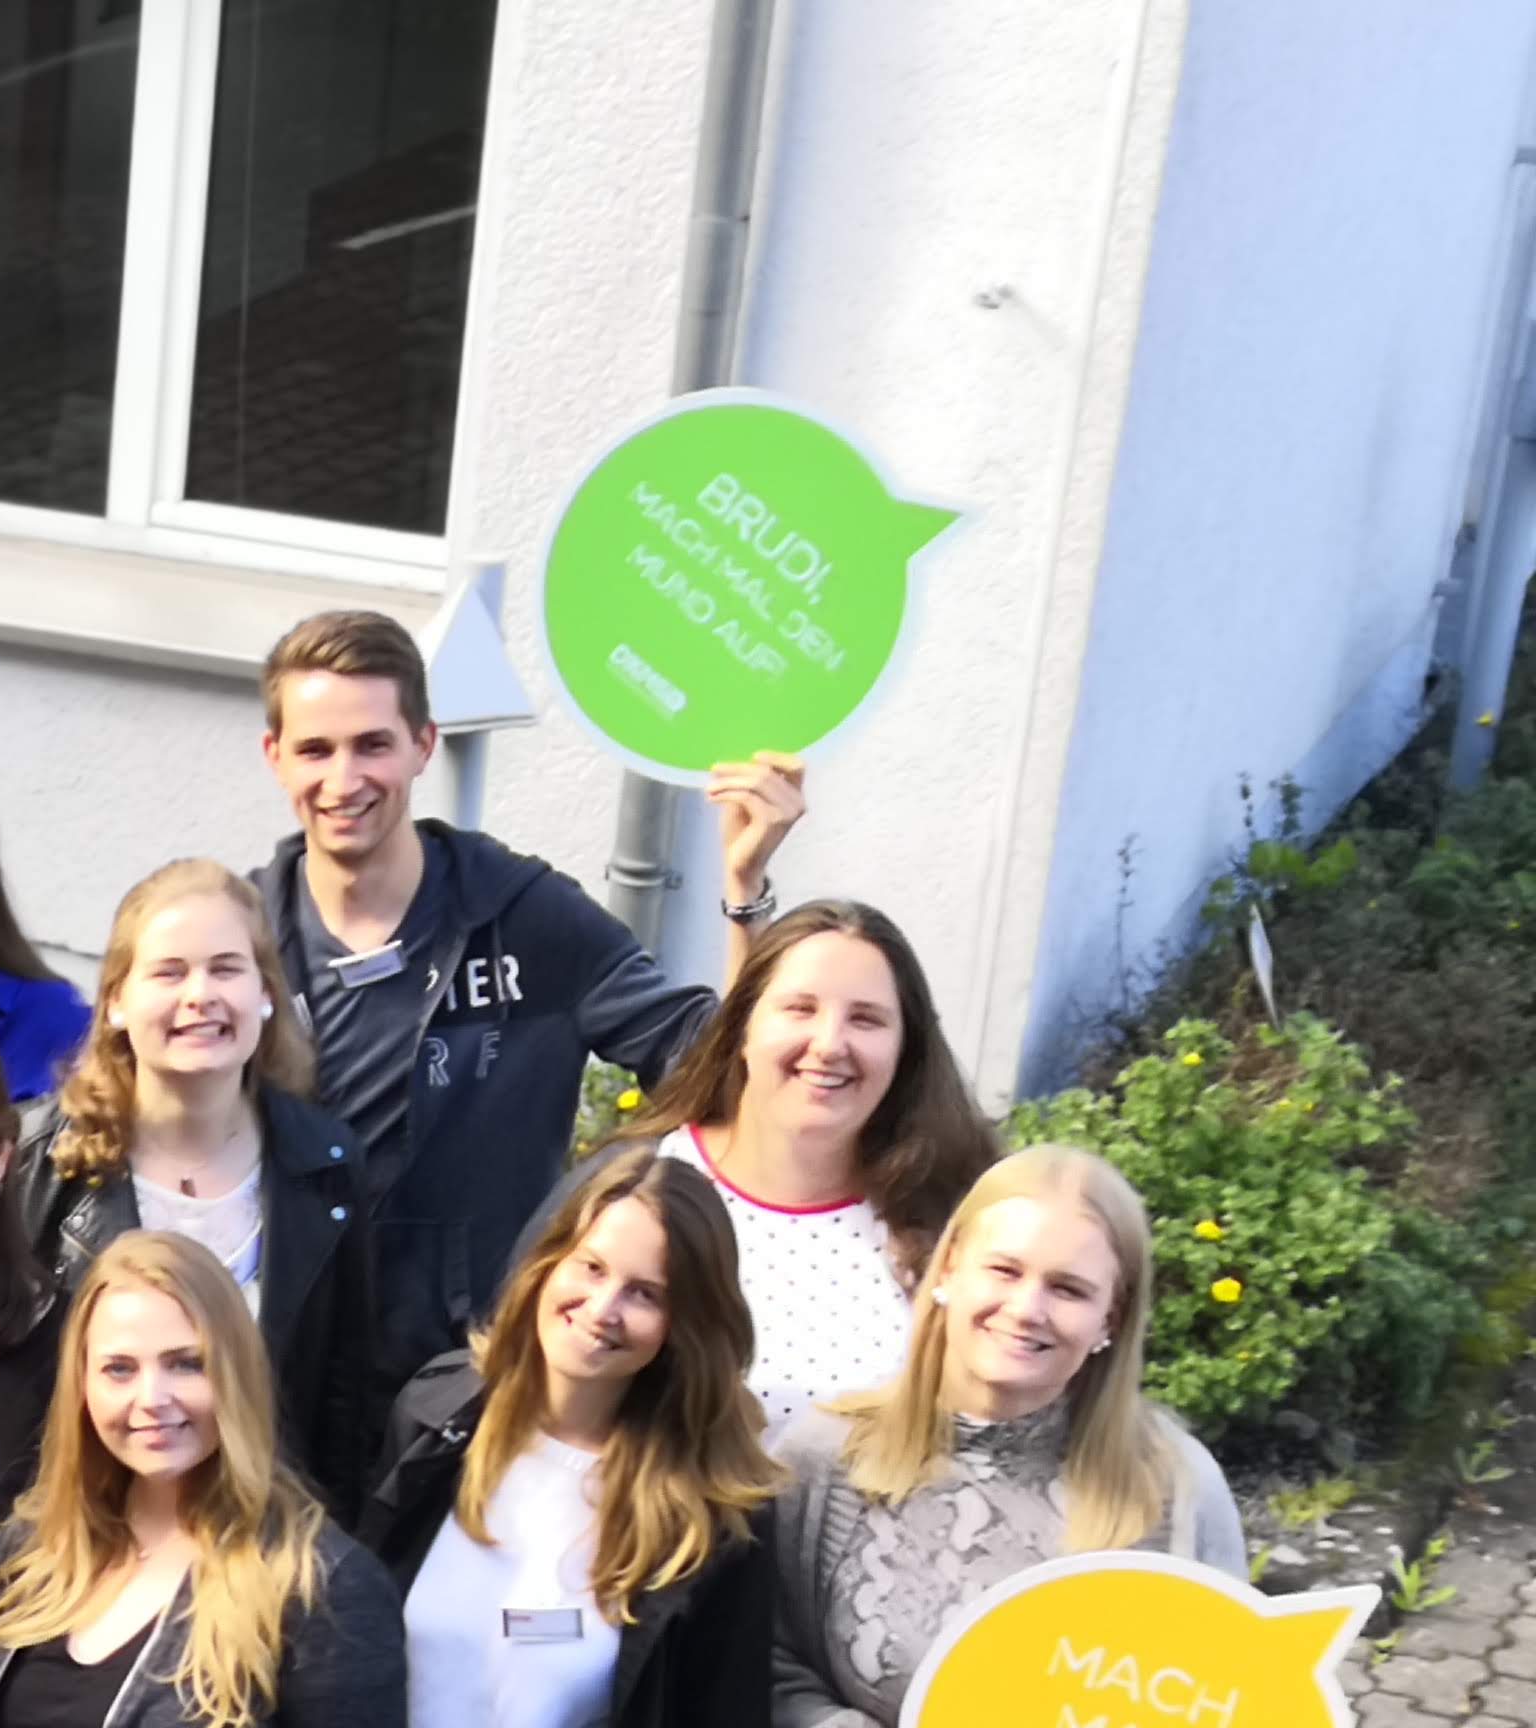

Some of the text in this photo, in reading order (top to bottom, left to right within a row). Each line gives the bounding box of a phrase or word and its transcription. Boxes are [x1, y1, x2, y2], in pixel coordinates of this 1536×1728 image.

[632, 481, 846, 671] MACH MAL DEN
